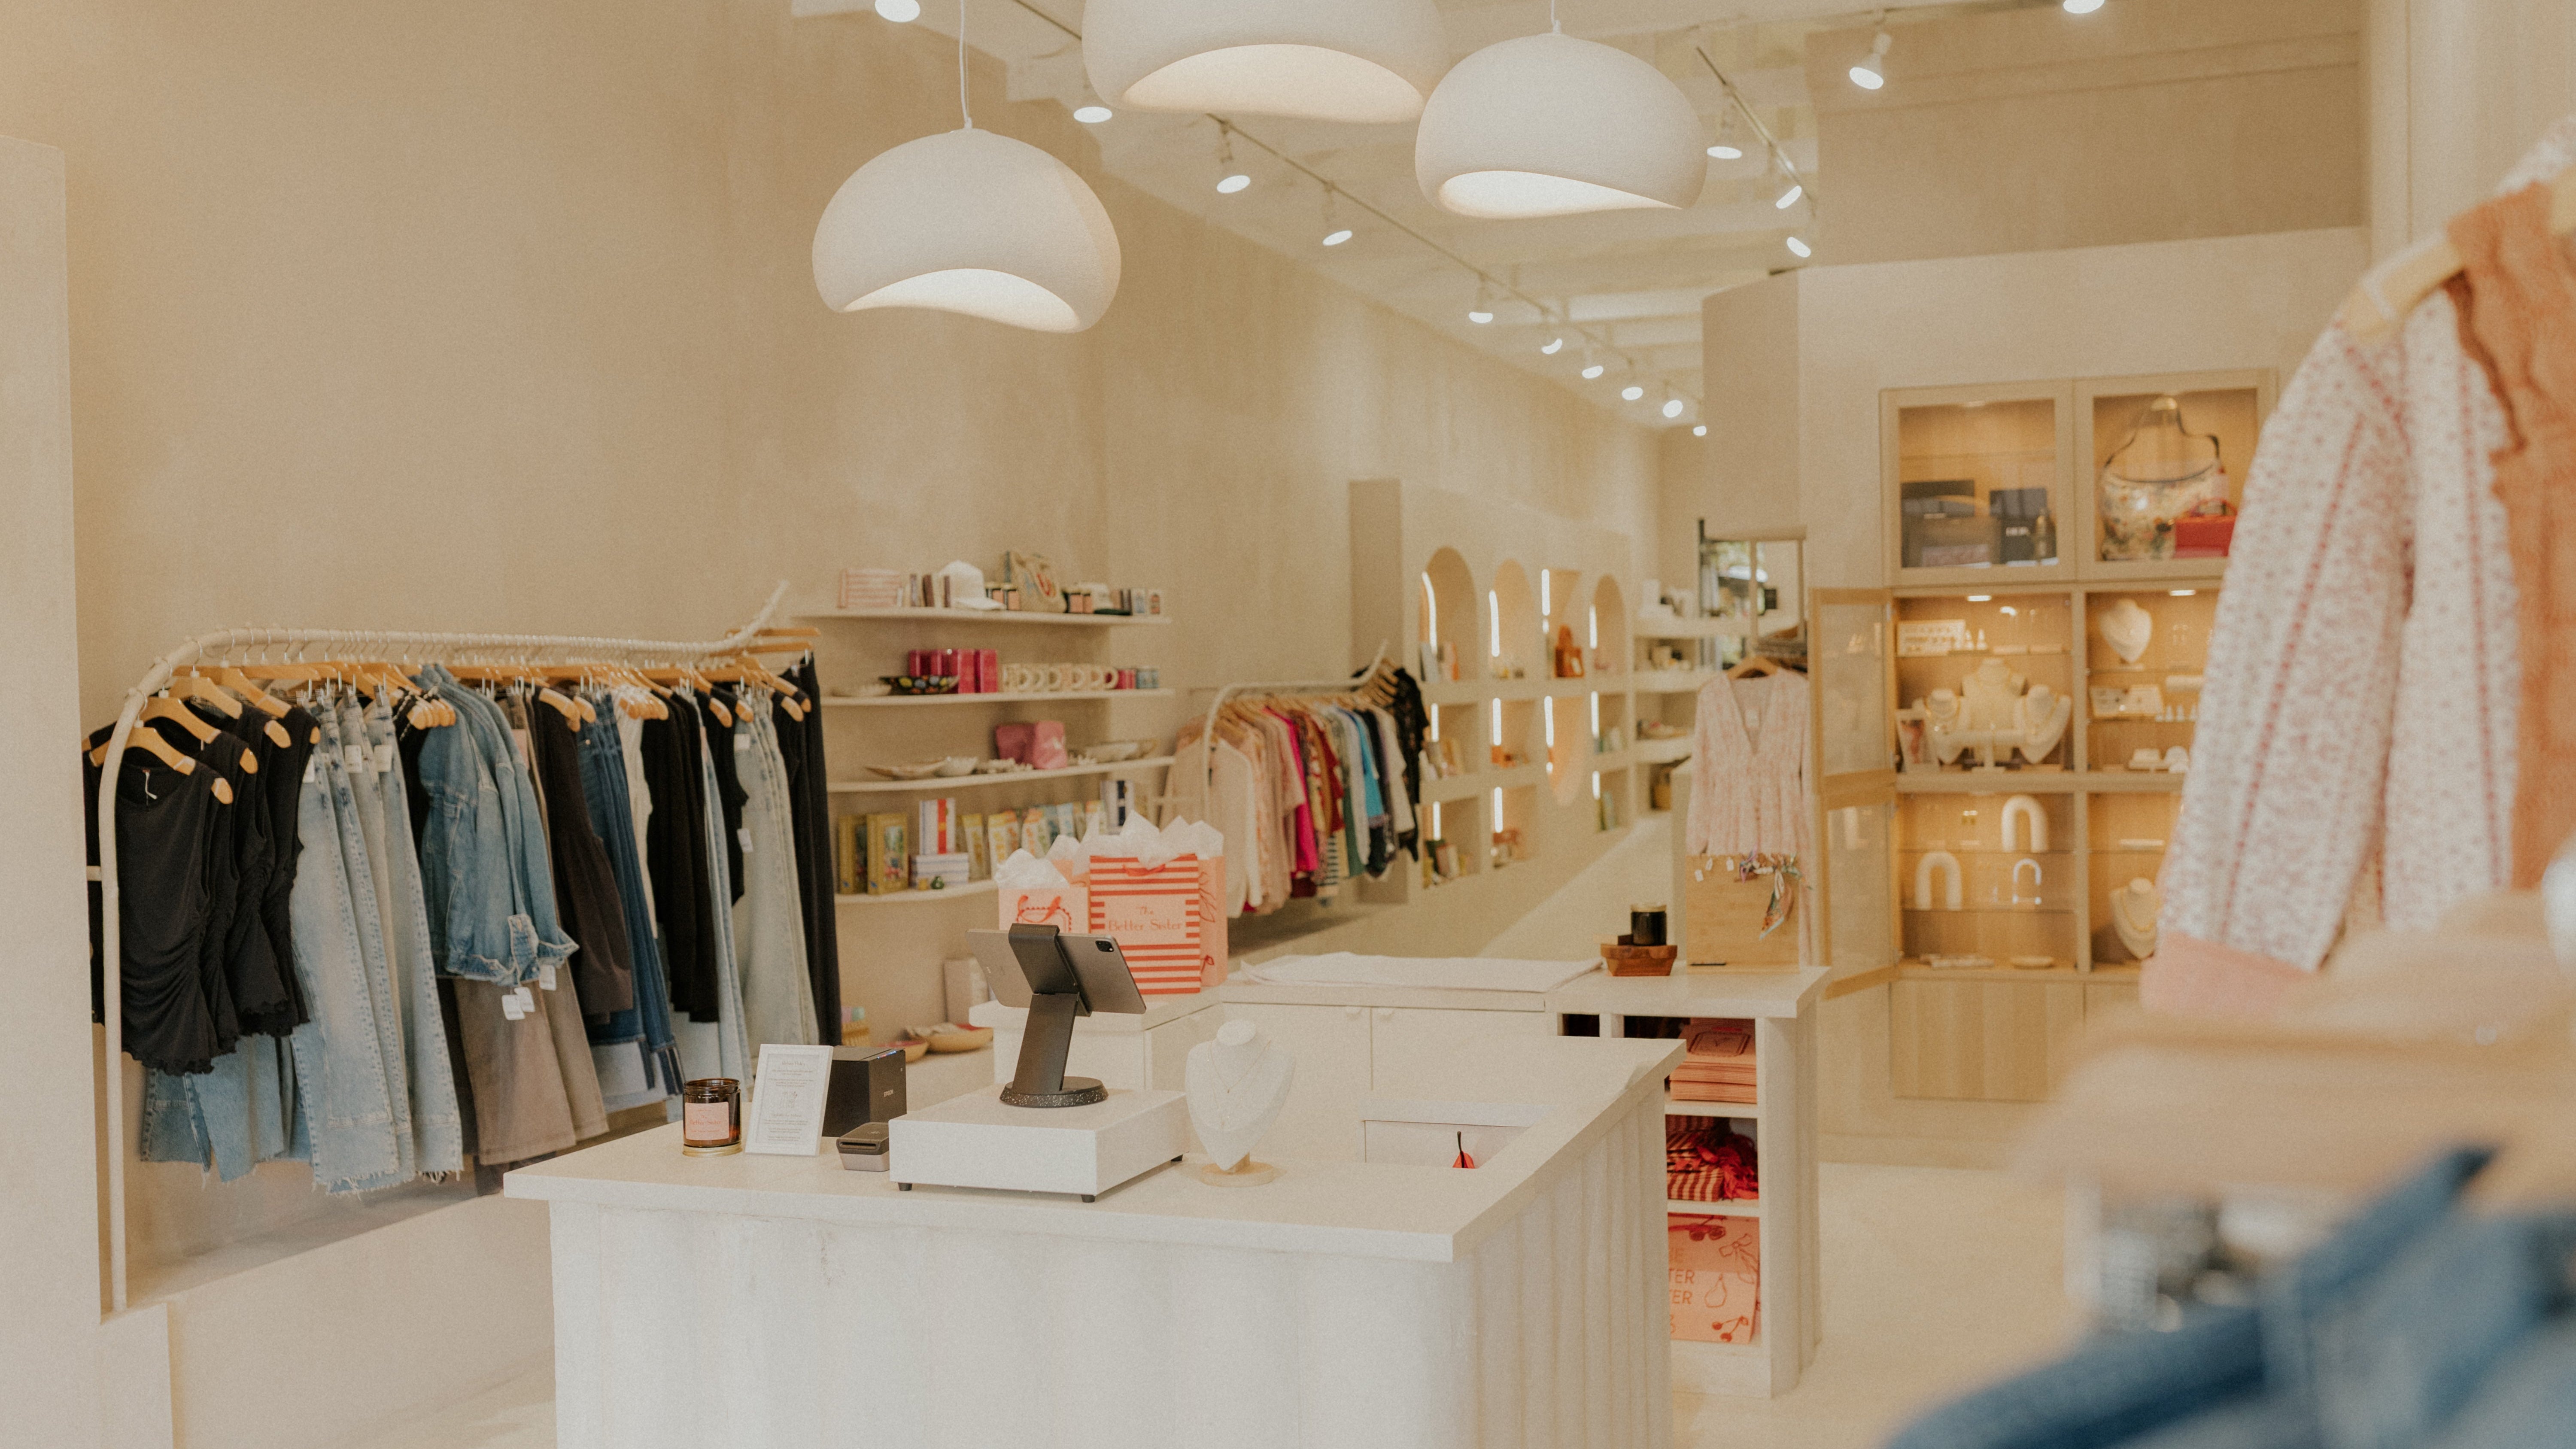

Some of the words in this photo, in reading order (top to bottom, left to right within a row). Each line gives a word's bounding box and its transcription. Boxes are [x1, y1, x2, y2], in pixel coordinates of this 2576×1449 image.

[1108, 920, 1144, 932] Better
[1150, 918, 1181, 931] Sister
[884, 1089, 893, 1097] EPSON
